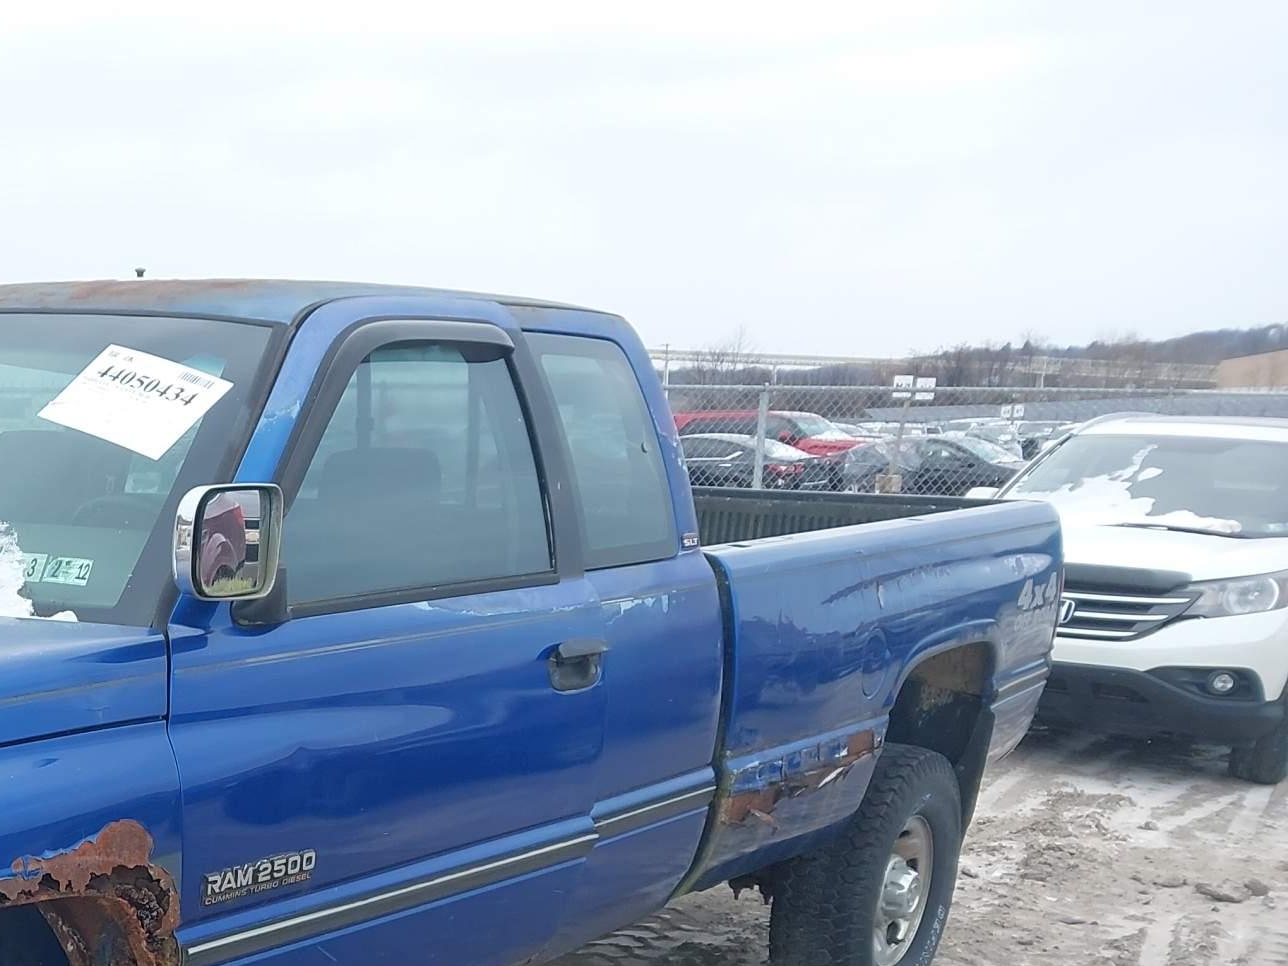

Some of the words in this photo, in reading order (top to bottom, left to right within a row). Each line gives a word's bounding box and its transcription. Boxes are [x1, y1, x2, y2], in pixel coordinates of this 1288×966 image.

[97, 365, 199, 406] 44050434
[26, 558, 38, 578] 3
[74, 563, 90, 580] 12
[1017, 571, 1058, 610] 4x4
[205, 888, 248, 905] CUMMINS
[250, 881, 279, 894] TURBO
[281, 872, 312, 886] DIESEL
[207, 866, 254, 896] RAM
[258, 850, 317, 883] 2500
